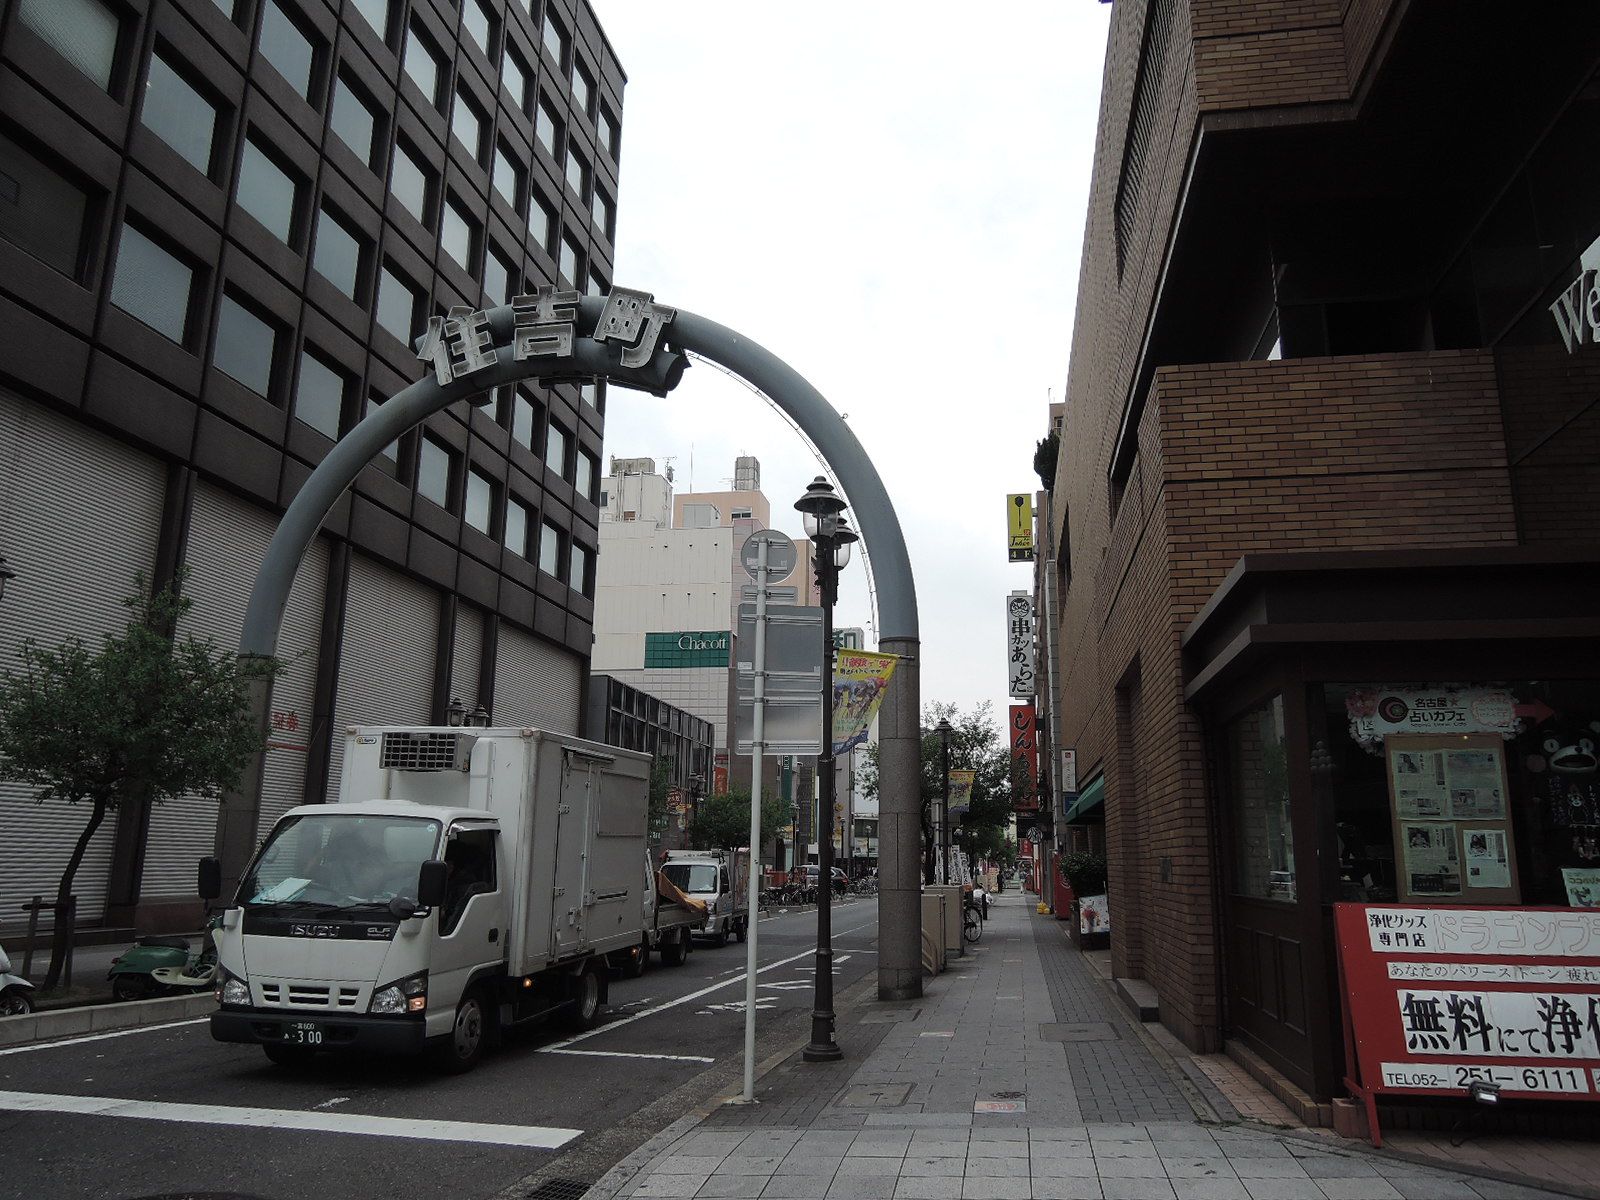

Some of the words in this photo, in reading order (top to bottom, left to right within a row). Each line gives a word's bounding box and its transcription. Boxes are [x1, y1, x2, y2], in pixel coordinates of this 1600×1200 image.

[416, 284, 678, 387] 住吉町
[678, 635, 727, 650] Chacott
[1409, 710, 1466, 723] 占いカフェ
[289, 924, 341, 937] ISUZU
[1379, 932, 1426, 947] 専門店
